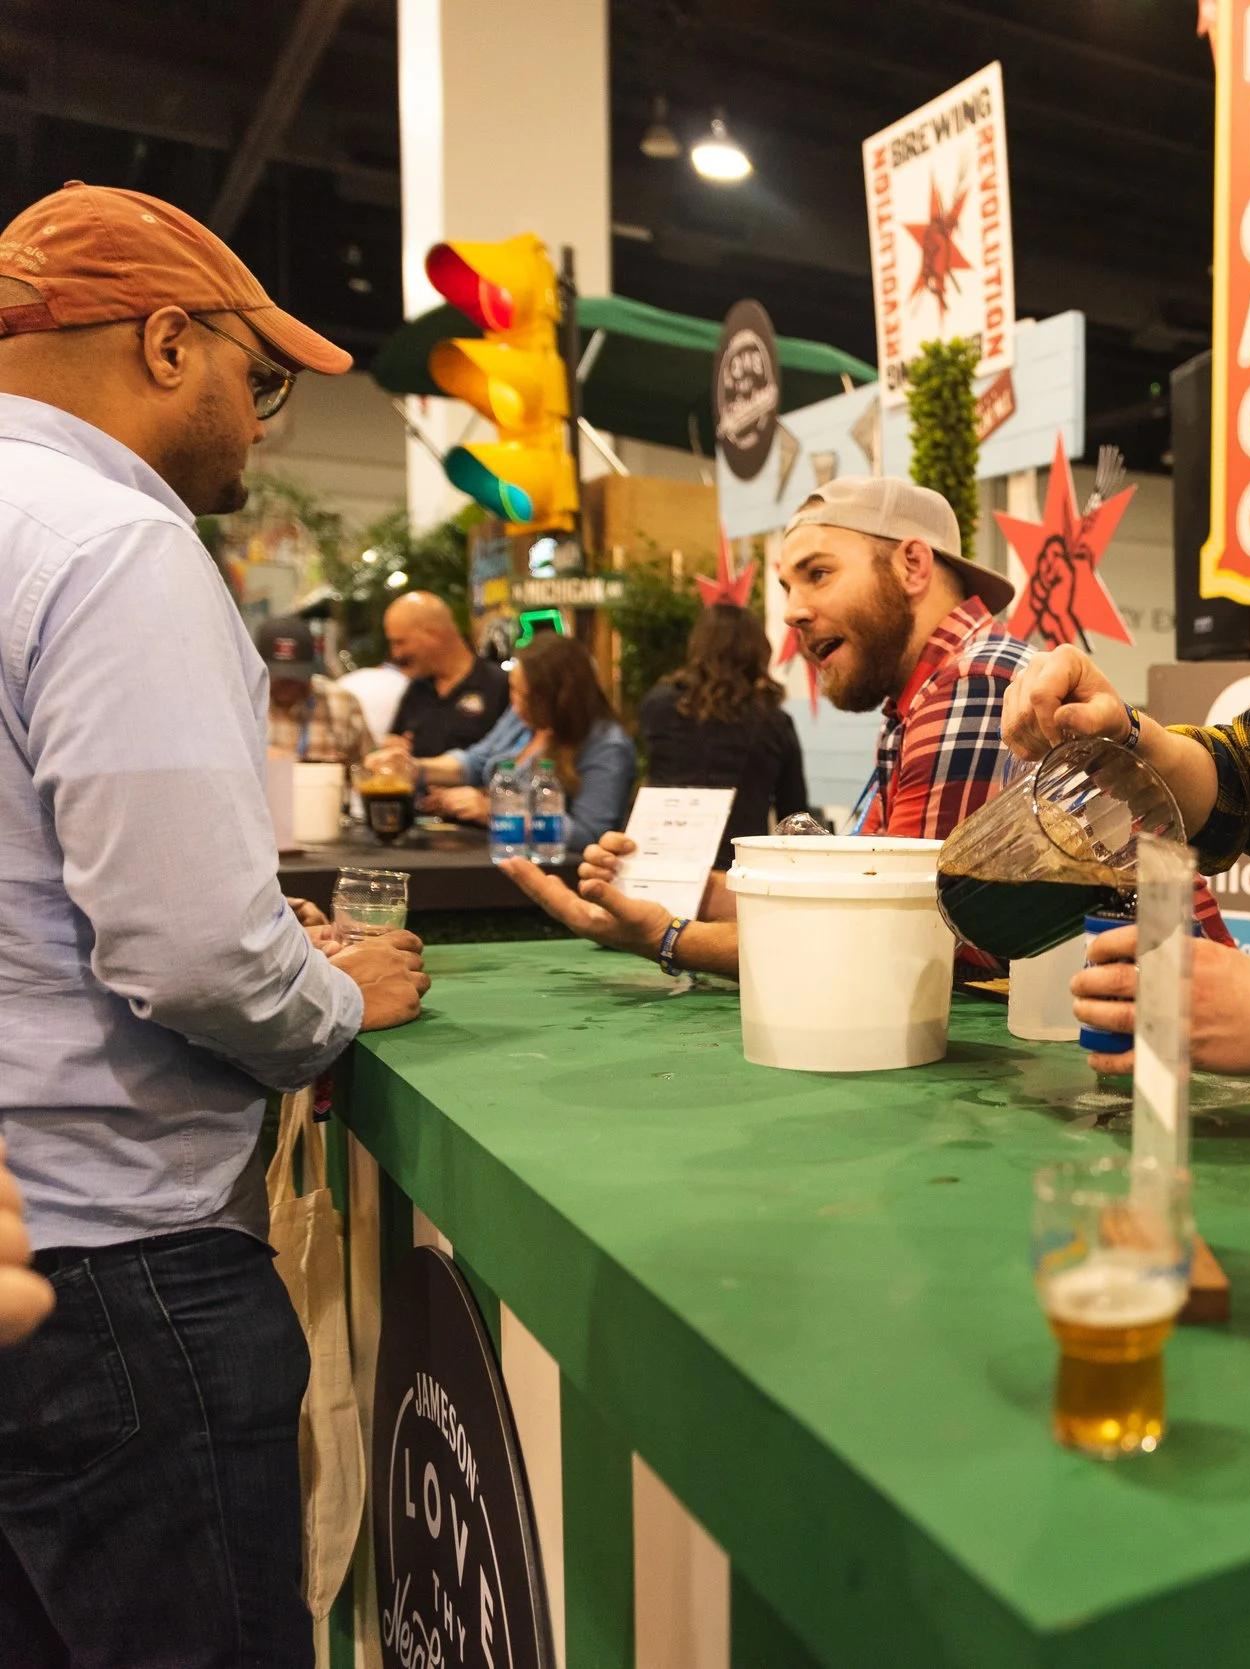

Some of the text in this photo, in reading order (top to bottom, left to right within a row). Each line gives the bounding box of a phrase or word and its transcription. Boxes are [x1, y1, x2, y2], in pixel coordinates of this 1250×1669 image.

[891, 86, 991, 169] BREWING
[873, 147, 901, 358] REVOLUTION
[976, 124, 1004, 359] REVOLUTION
[416, 1372, 480, 1502] JAMESON
[404, 1447, 494, 1669] LOVE
[433, 1569, 466, 1663] THY
